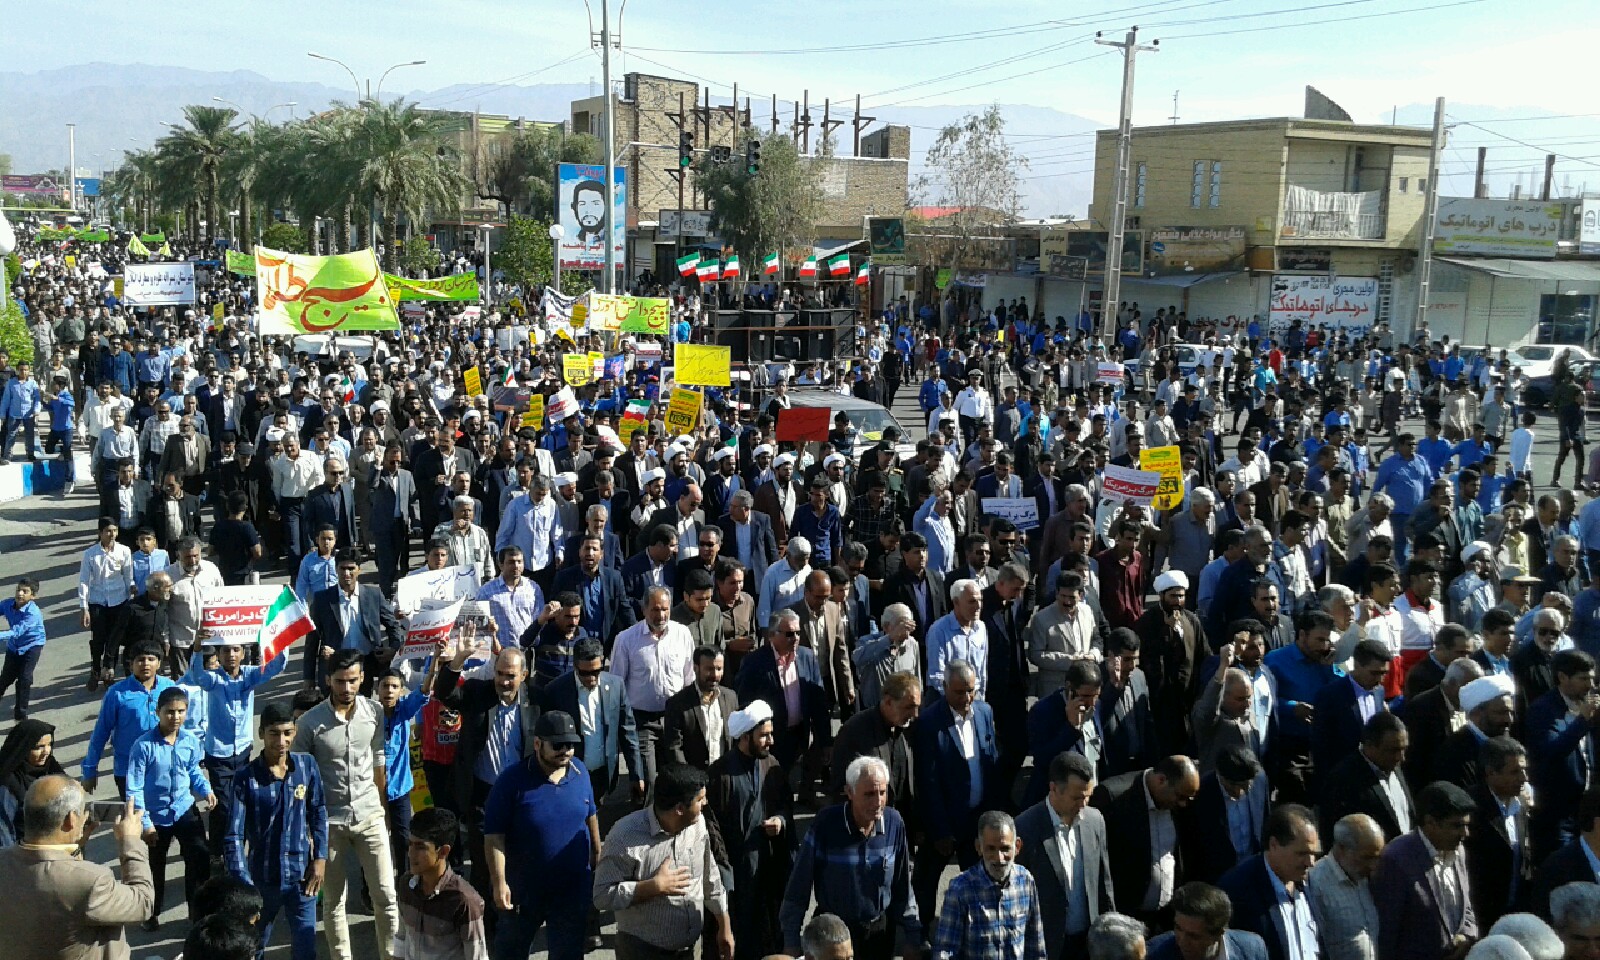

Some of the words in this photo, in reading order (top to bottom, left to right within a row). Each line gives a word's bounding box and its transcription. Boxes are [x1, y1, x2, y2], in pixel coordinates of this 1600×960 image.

[1439, 214, 1495, 232] اتوماتیک
[1498, 216, 1524, 233] های
[1528, 220, 1556, 236] درب
[647, 299, 669, 327] بسیج
[1138, 485, 1155, 496] مرگ
